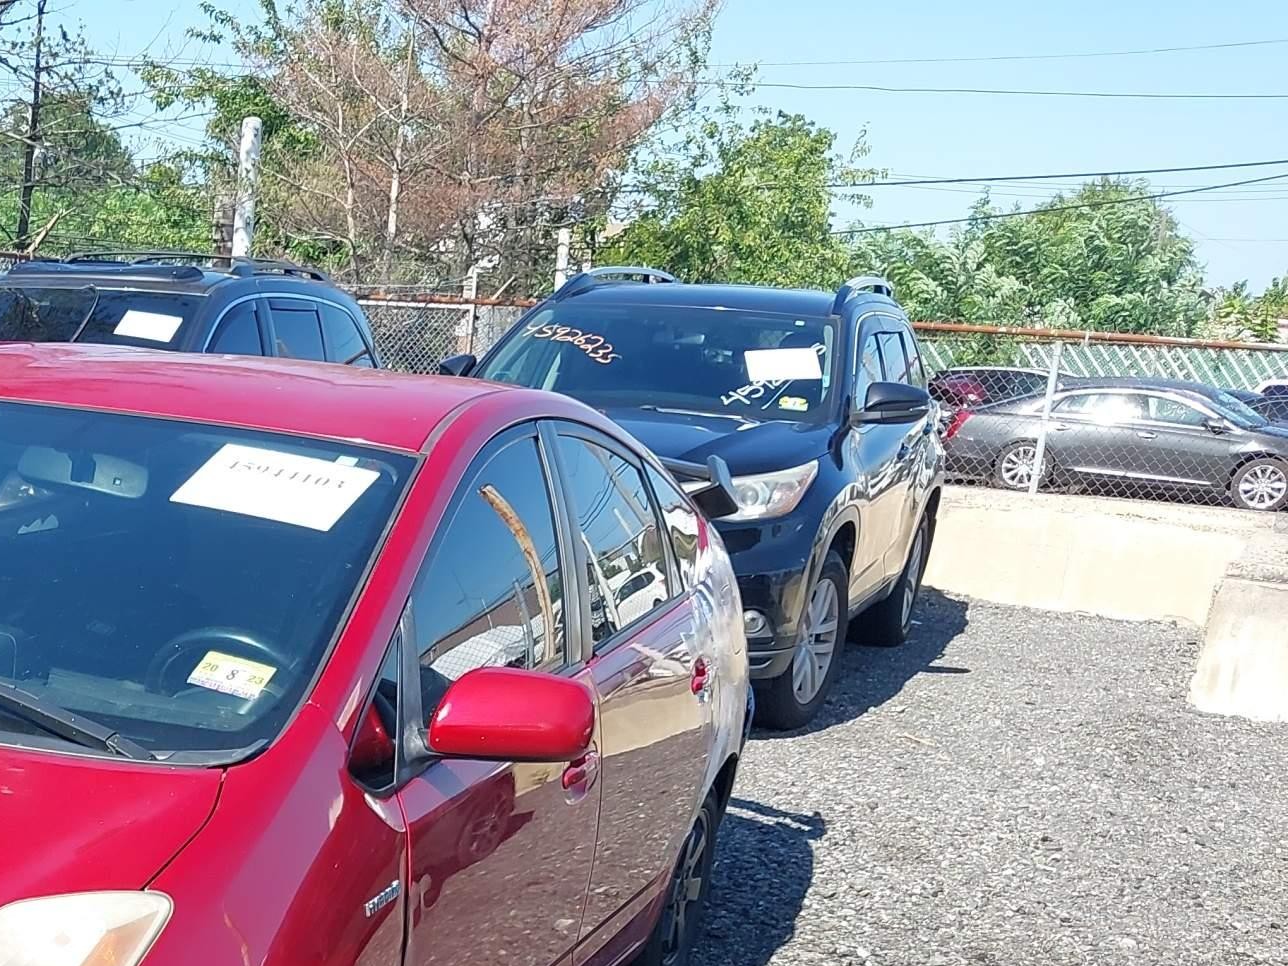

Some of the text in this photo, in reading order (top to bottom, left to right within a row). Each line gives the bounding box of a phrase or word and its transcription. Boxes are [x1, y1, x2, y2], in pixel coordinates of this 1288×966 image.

[522, 322, 623, 364] 45926235
[201, 661, 219, 673] 20
[225, 668, 239, 681] 8
